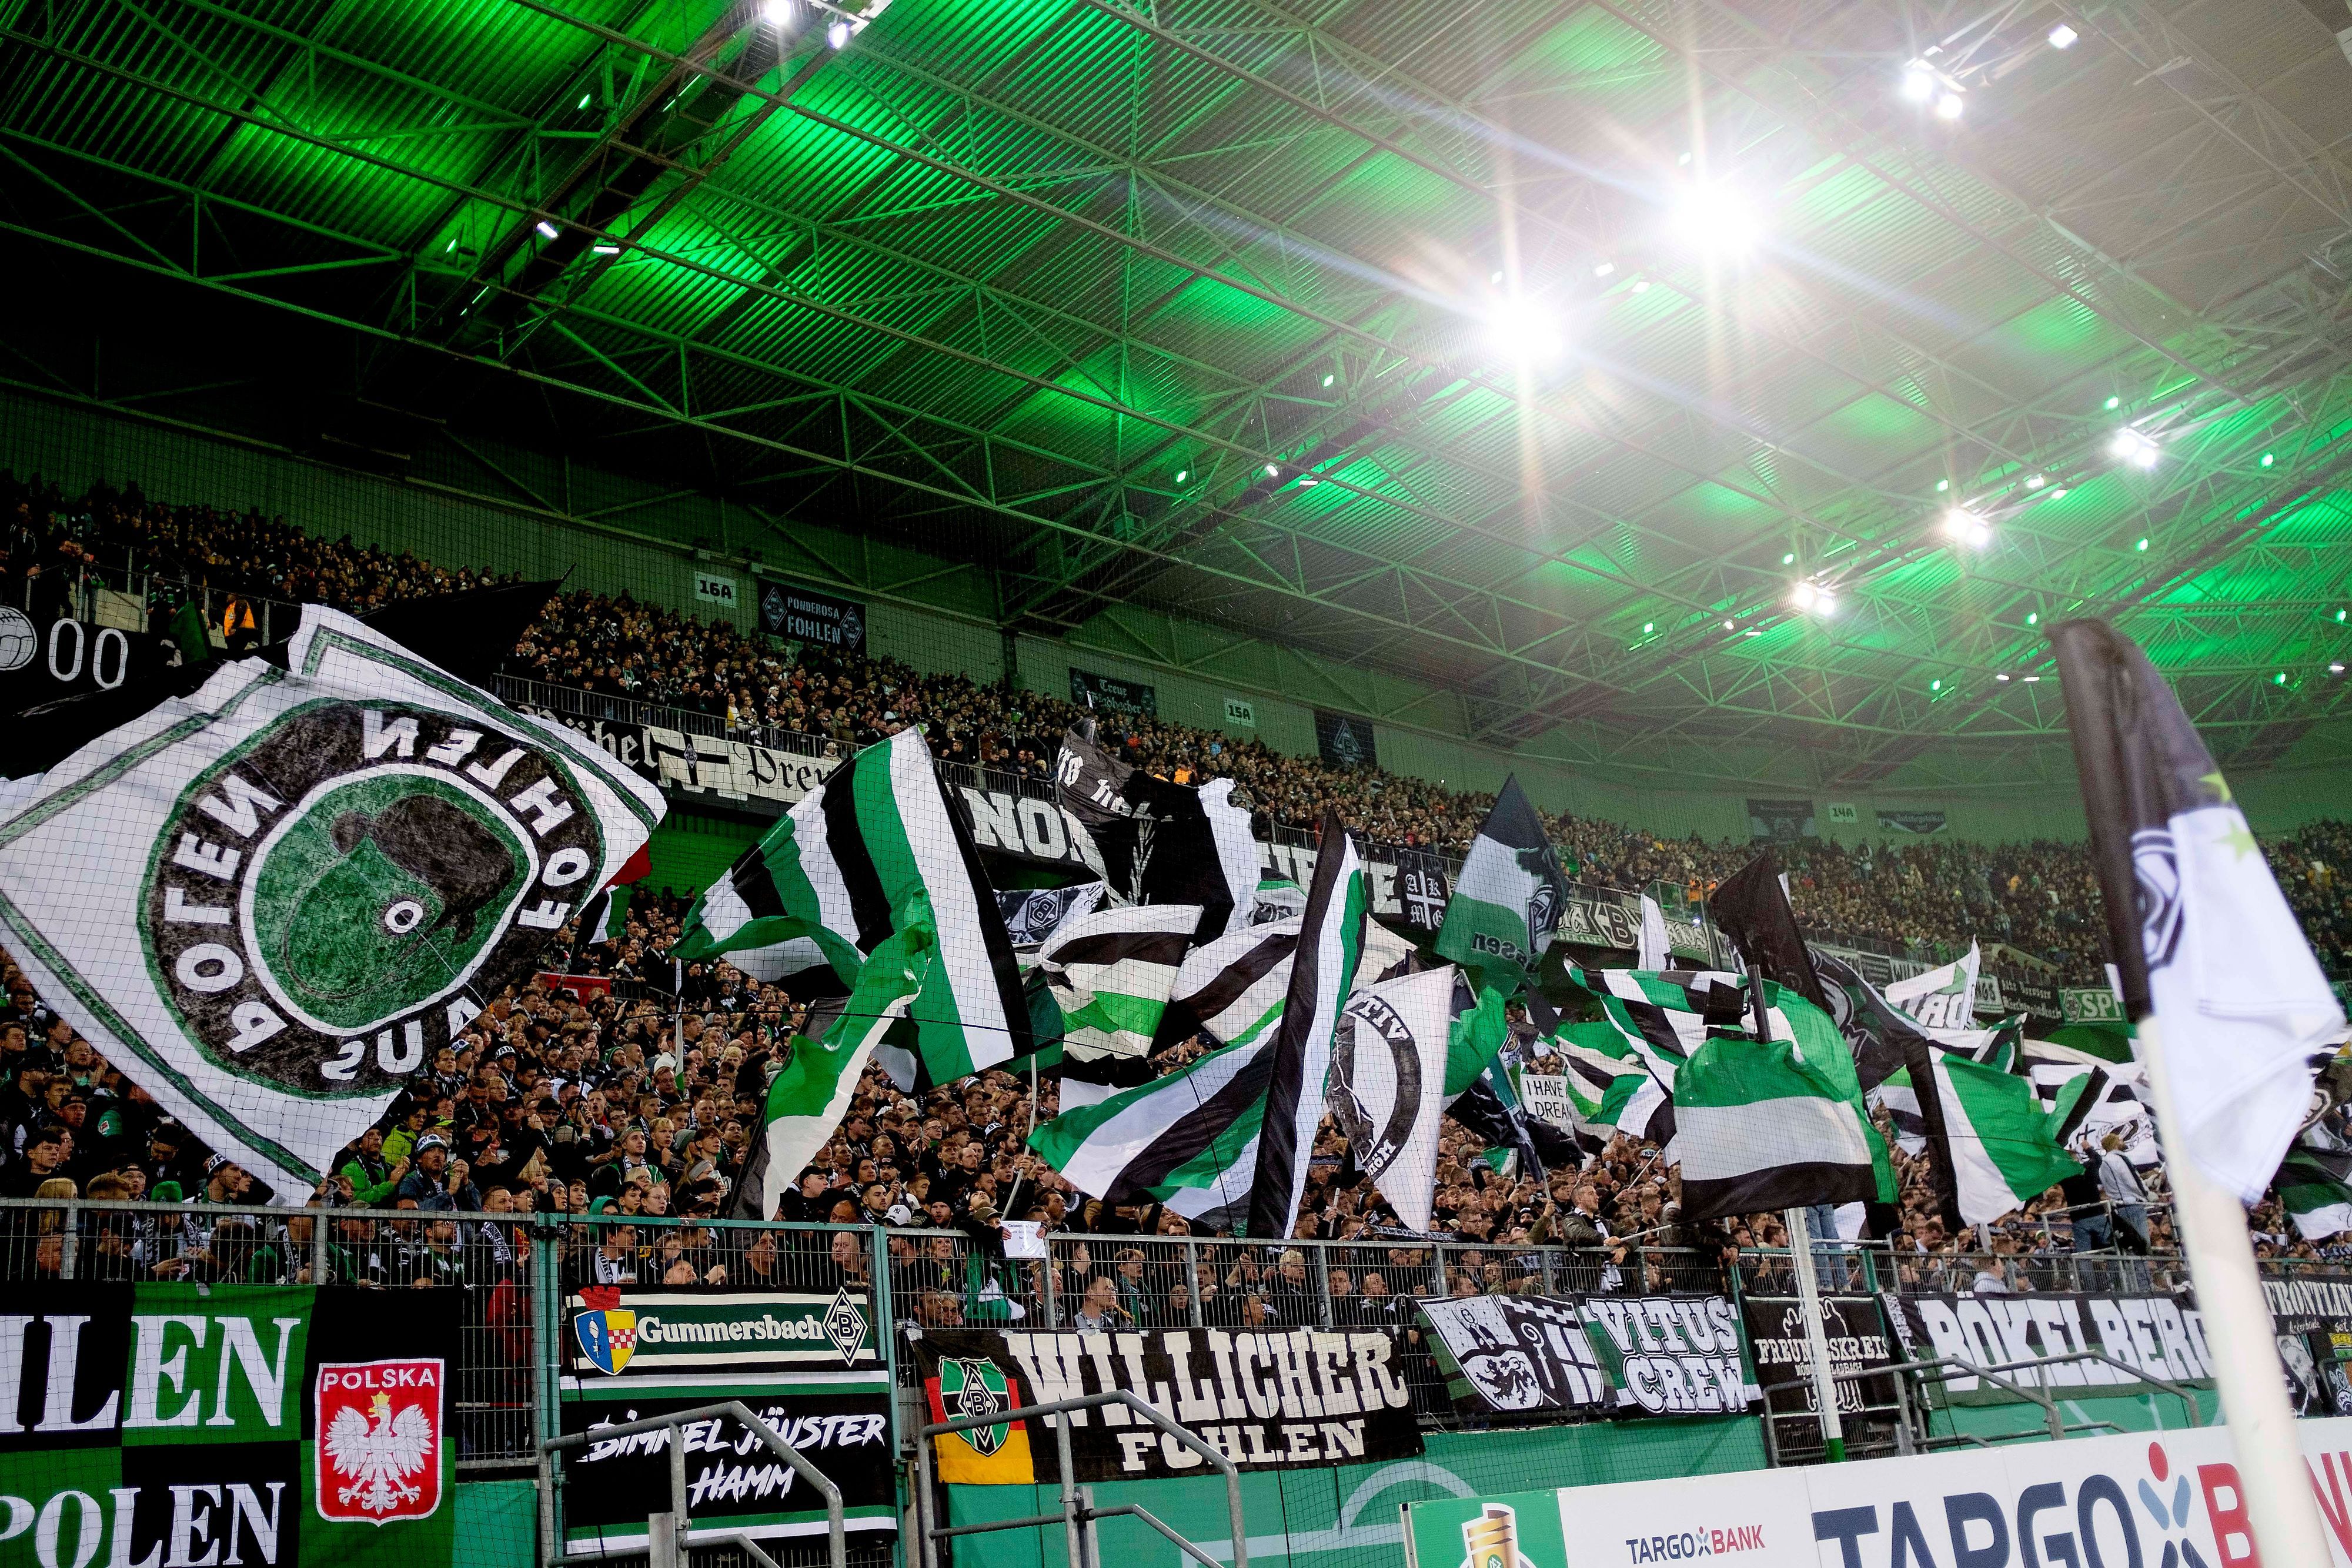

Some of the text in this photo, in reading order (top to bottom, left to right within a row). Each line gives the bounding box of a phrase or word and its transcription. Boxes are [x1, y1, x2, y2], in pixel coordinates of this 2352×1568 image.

[699, 579, 733, 600] 16A
[787, 596, 840, 620] PONDEROSA
[1228, 706, 1251, 721] 15A
[1832, 807, 1853, 818] 14A
[1526, 1080, 1563, 1096] I HAVE
[637, 1314, 826, 1344] Gummersbach
[1586, 1295, 1739, 1355] VITUS
[322, 1368, 436, 1393] POLSKA
[1007, 1331, 1409, 1429] WILLICHER
[1623, 1353, 1748, 1413] CREW
[686, 1459, 796, 1507] HAMM
